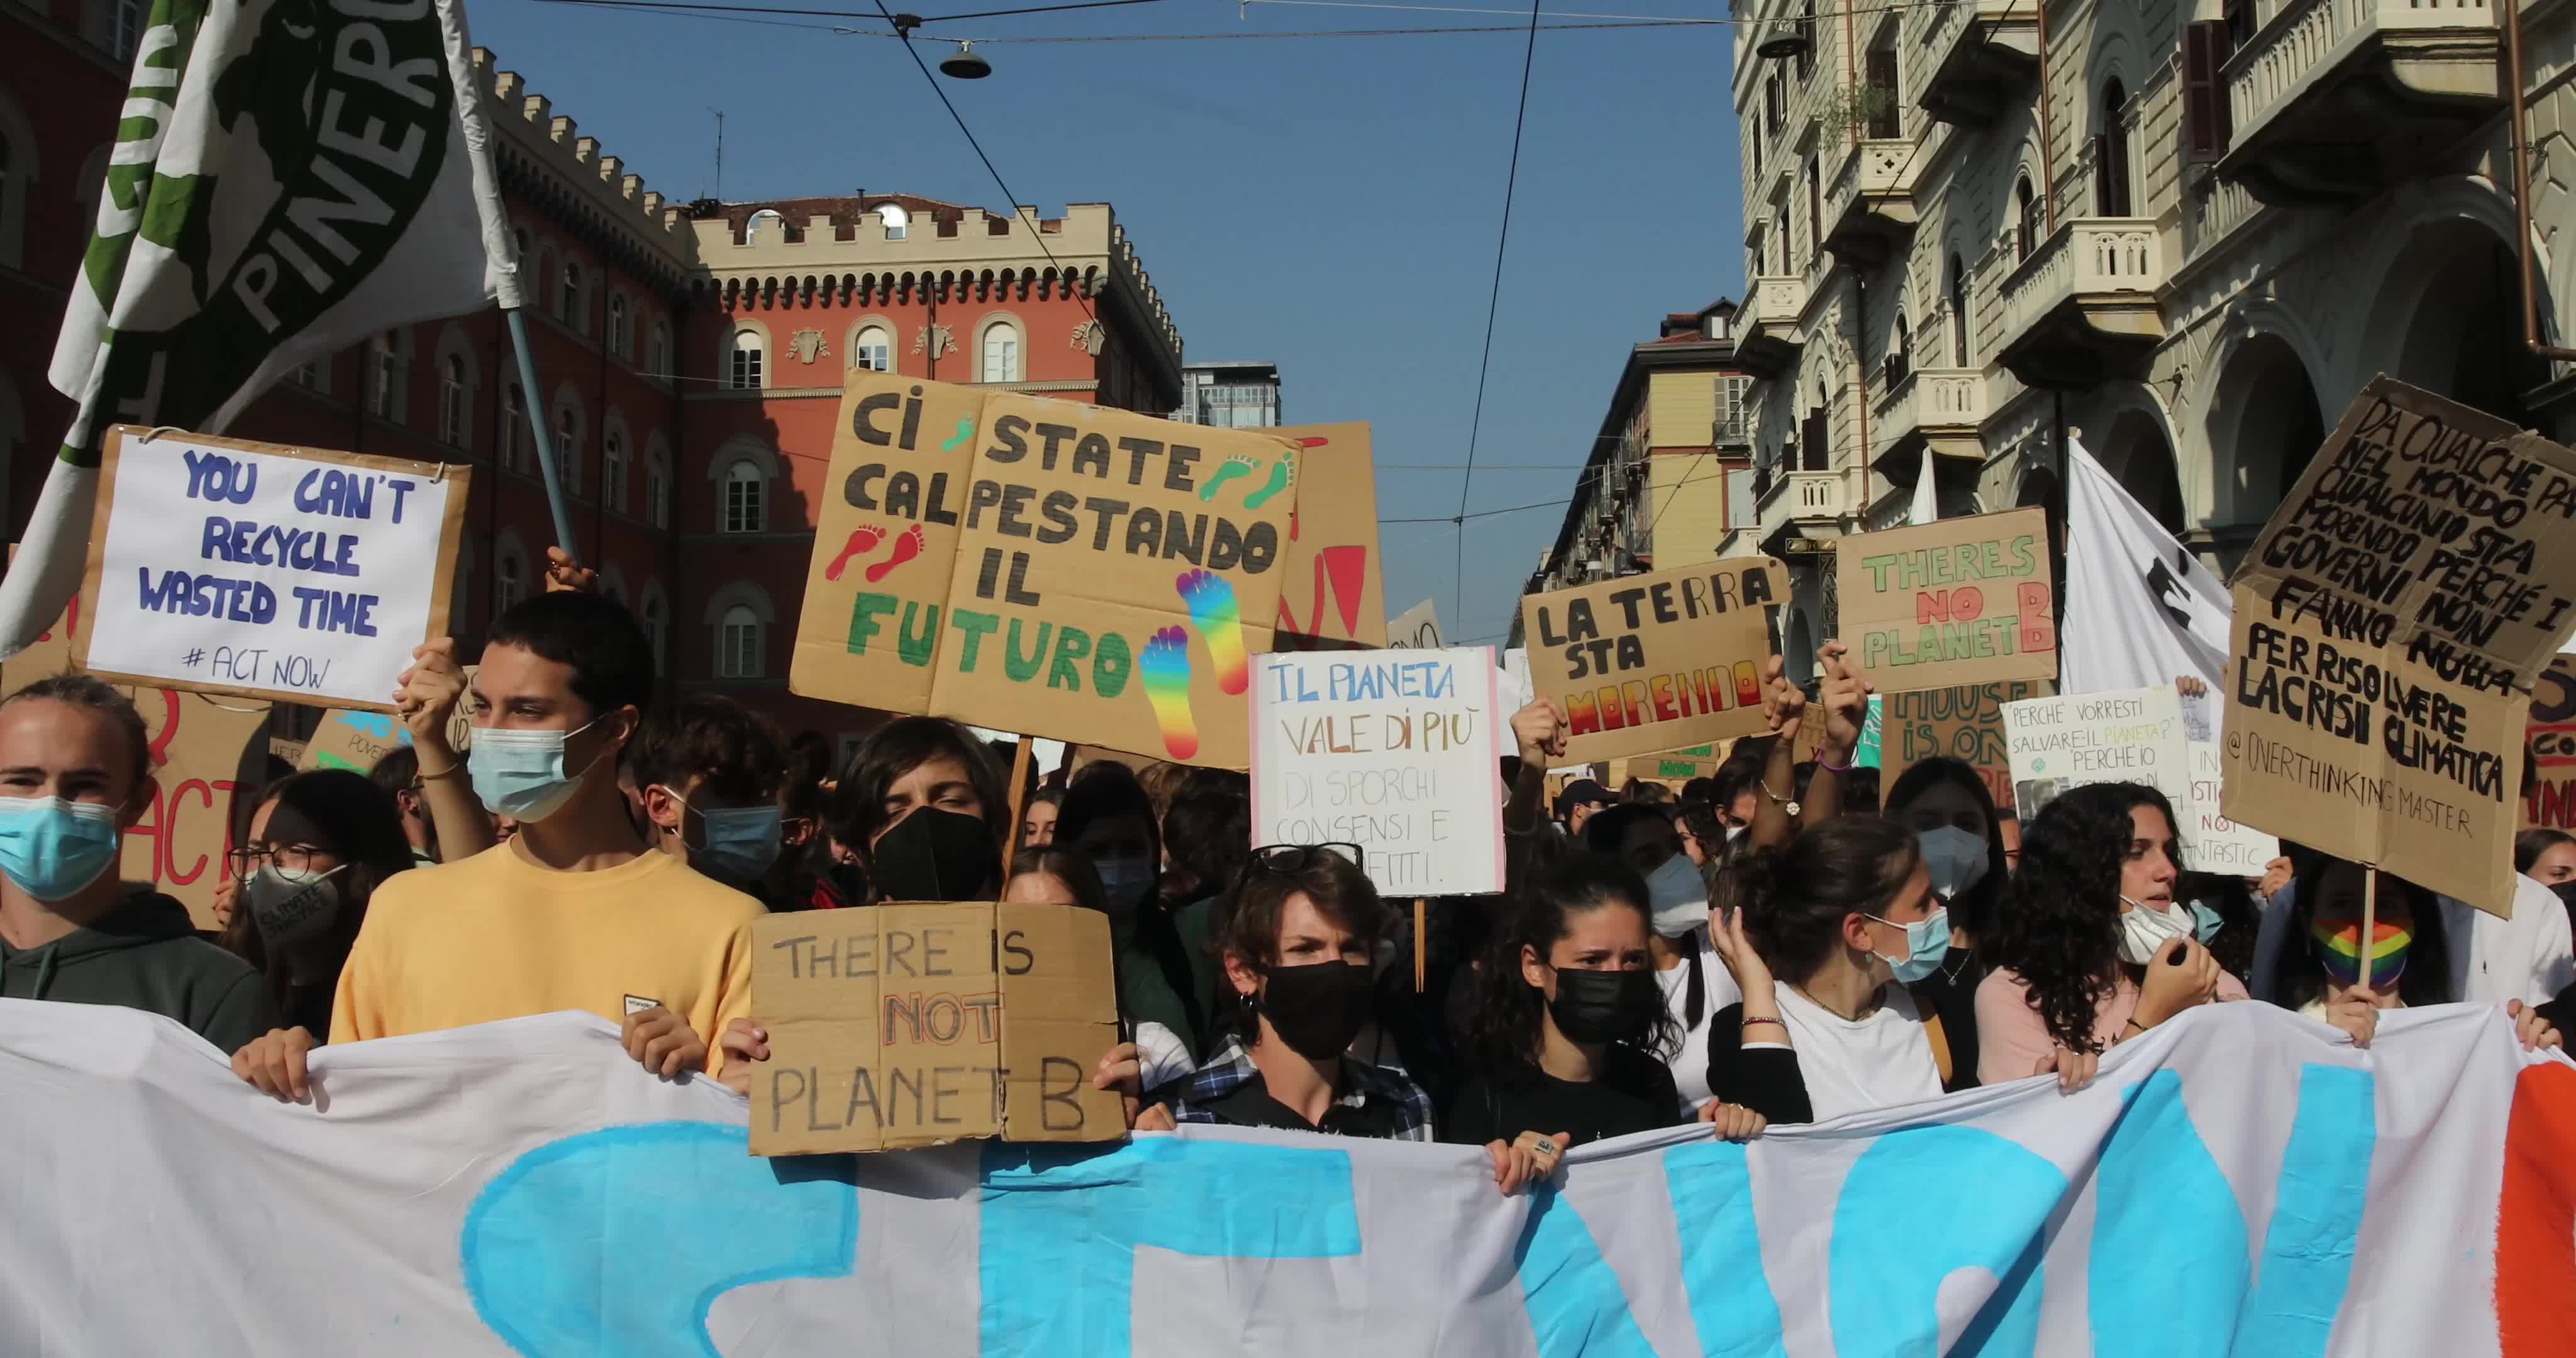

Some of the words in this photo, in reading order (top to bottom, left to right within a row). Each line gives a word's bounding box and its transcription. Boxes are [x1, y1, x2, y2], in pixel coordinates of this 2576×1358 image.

[985, 414, 1201, 492] STATE
[2355, 397, 2403, 446] DA
[2400, 415, 2544, 495] QUALCHE
[184, 450, 257, 504] YOU
[294, 468, 414, 523] CAN'T
[844, 463, 1279, 574] CALPESTANDO
[2313, 464, 2469, 544] QUALCUNO
[2457, 526, 2536, 575] STA
[2336, 440, 2393, 480] NEL
[2405, 466, 2527, 529] MONDO
[201, 516, 359, 577] RECYCLE
[975, 548, 1041, 607] IL
[1862, 534, 2036, 592] THERES
[2291, 495, 2422, 565] MORENDO
[2418, 548, 2548, 623] PERCHÉ
[2534, 597, 2572, 632] I
[139, 566, 277, 624] WASTED
[292, 587, 378, 637] TIME
[1538, 598, 1599, 648] LA
[1609, 567, 1772, 629] TERRA
[1916, 586, 1984, 625] NO
[2262, 526, 2414, 606] GOVERNI
[2418, 592, 2504, 648] NON
[847, 591, 1131, 698] FUTURO
[1565, 634, 1645, 680] STA
[1864, 614, 2019, 669] PLANET
[2018, 582, 2055, 653] B
[2271, 575, 2397, 649] FANNO
[2407, 631, 2514, 697] NULLA
[273, 655, 330, 689] NOW
[1268, 663, 1319, 704] IL
[1330, 661, 1454, 702] PIANETA
[1565, 660, 1762, 736] MORENDO
[1281, 714, 1372, 755] VALE
[1952, 726, 2009, 765] ON
[2384, 714, 2502, 802] CLIMATICA
[1285, 771, 1313, 810] DI
[1326, 766, 1437, 805] SPORCHI
[2248, 732, 2395, 812] OVERTHINKING
[2399, 787, 2472, 838] MASTER
[1276, 814, 1411, 846] CONSENSI
[1431, 810, 1450, 841] E
[774, 930, 953, 979] THERE
[990, 929, 1033, 975] IS
[883, 991, 1005, 1046] NOT
[773, 1066, 1010, 1132] PLANET
[1041, 1056, 1084, 1132] B
